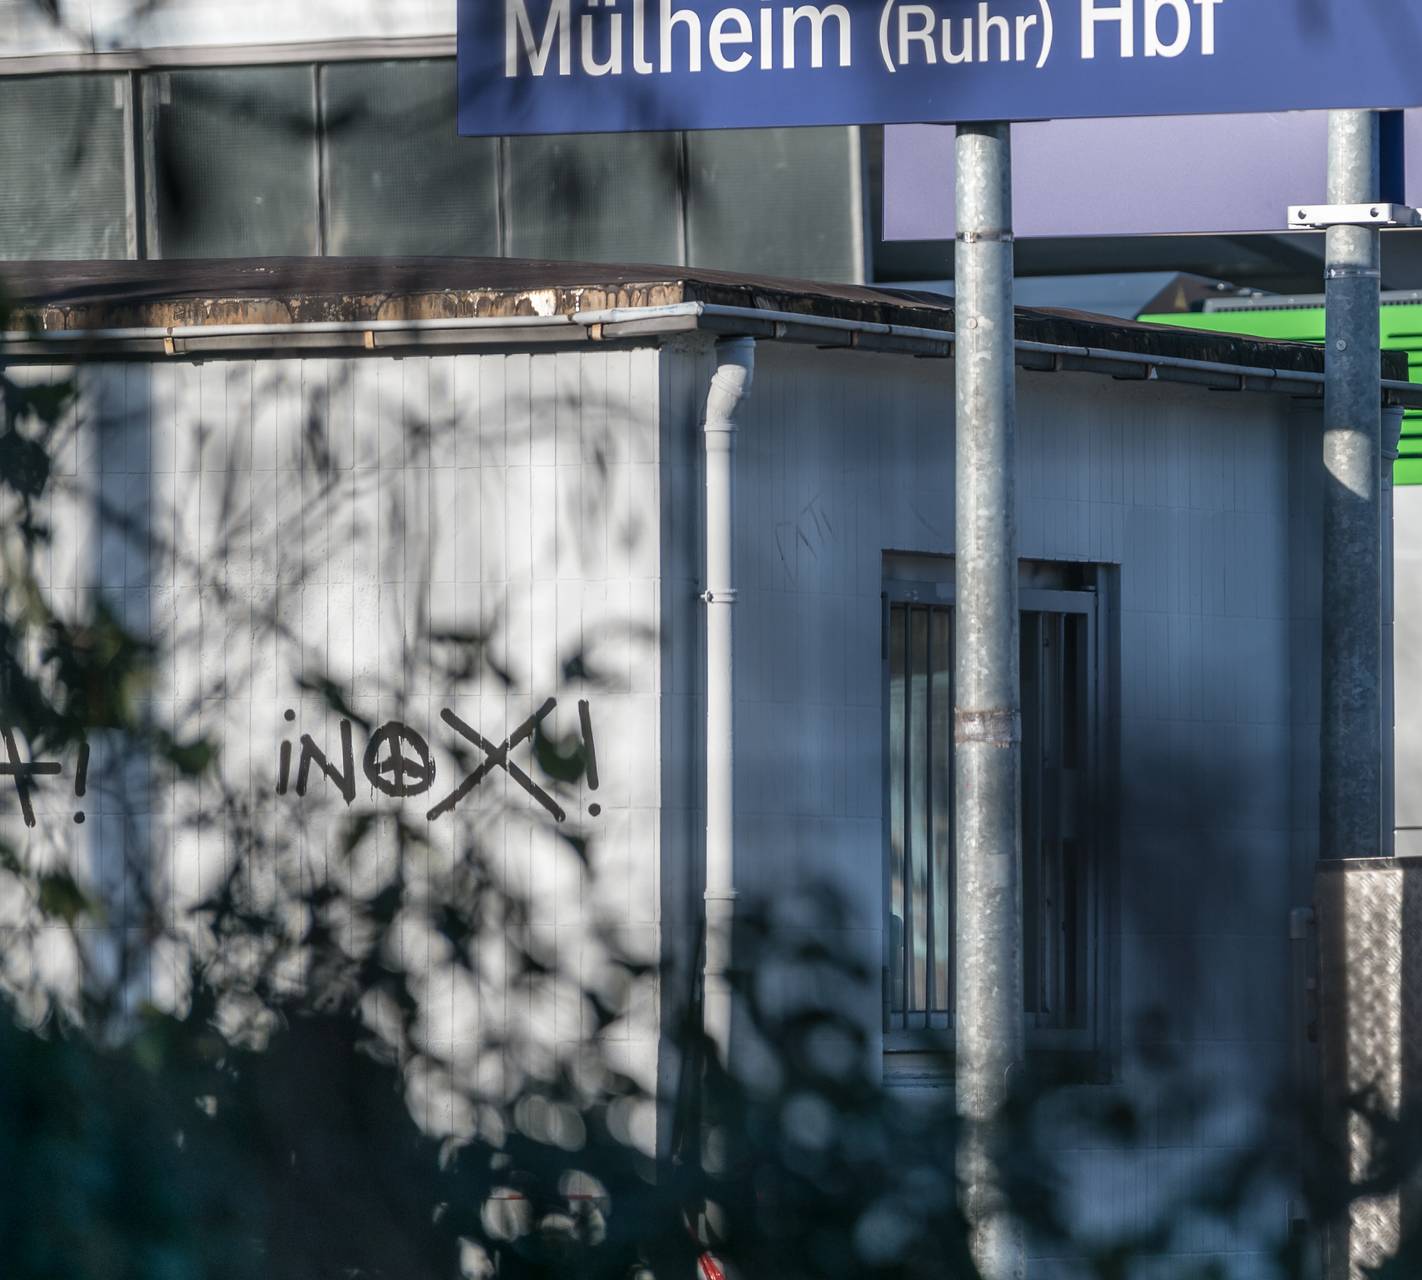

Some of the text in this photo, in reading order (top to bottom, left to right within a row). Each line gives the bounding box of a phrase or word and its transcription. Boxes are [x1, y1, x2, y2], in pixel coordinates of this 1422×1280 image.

[505, 0, 1224, 78] Mülheim (Ruhr) Hbf
